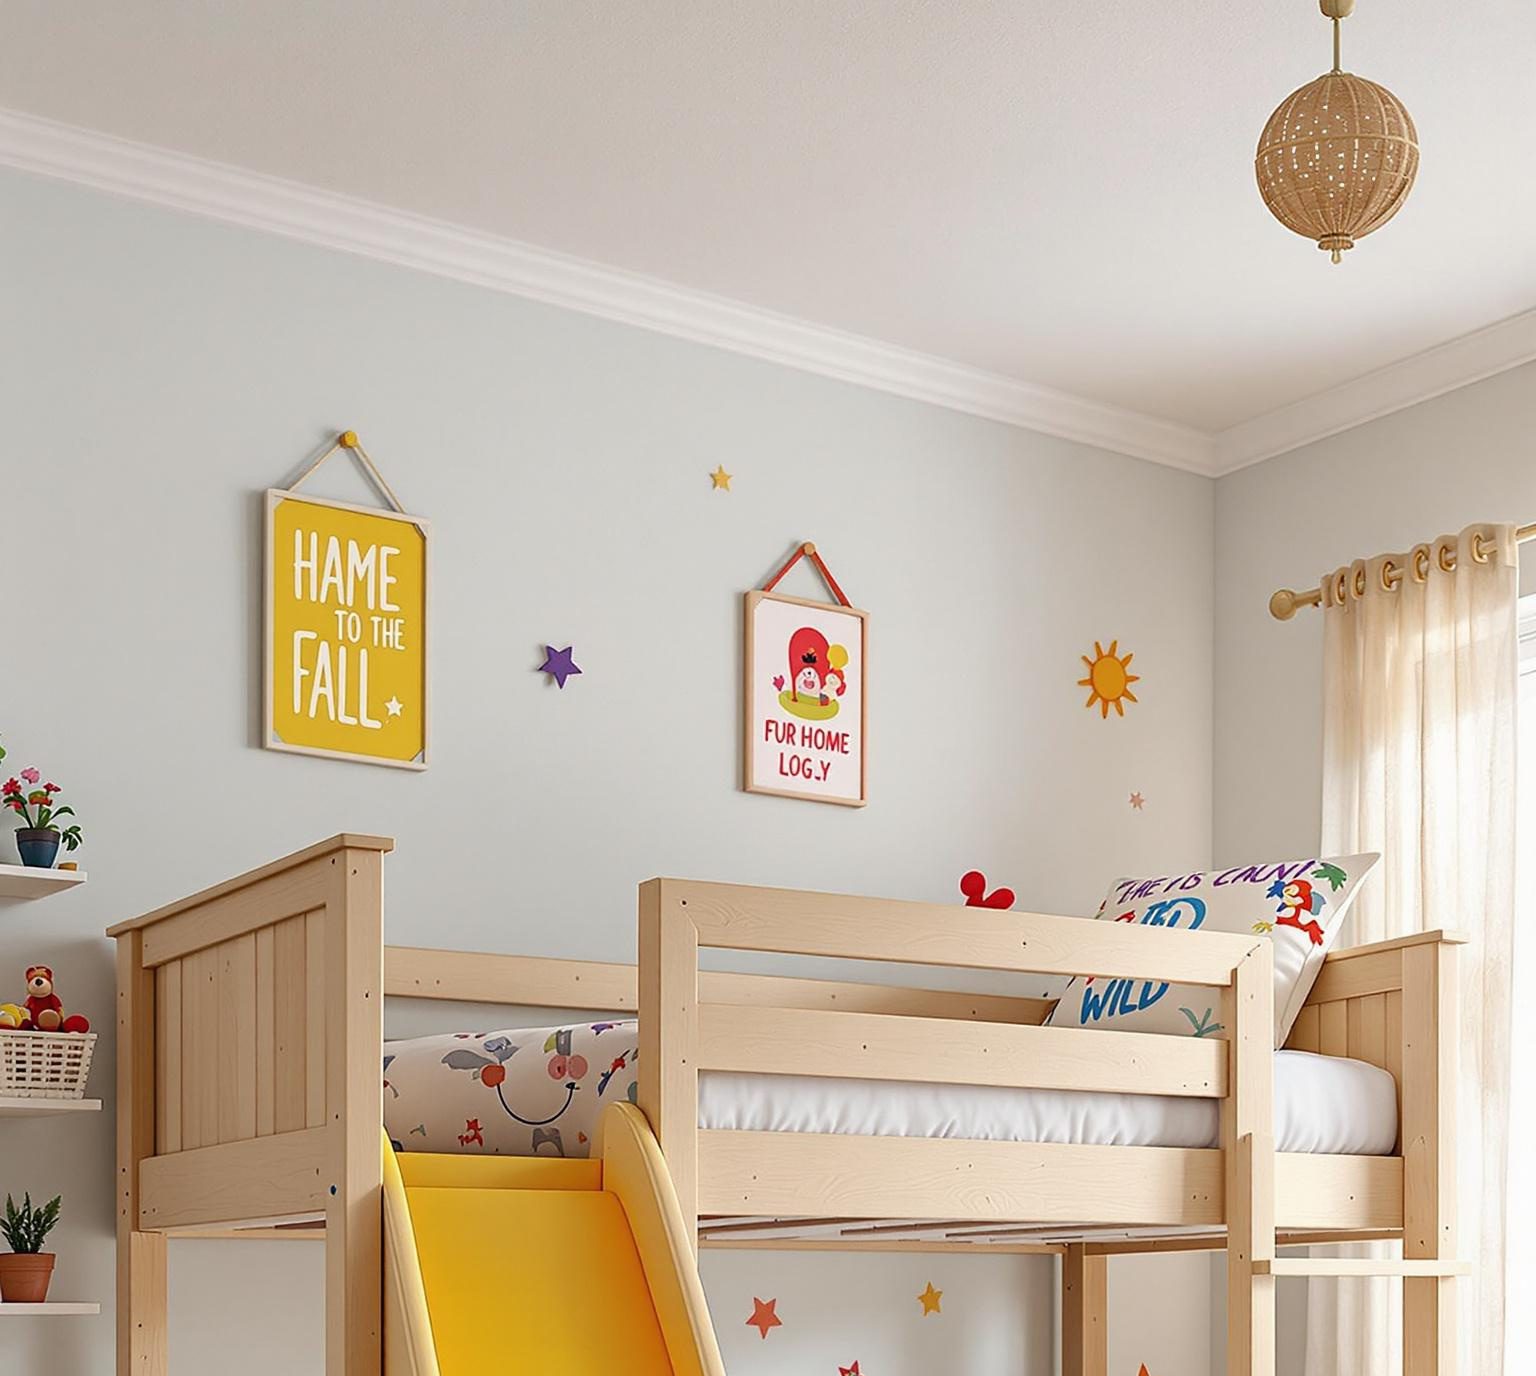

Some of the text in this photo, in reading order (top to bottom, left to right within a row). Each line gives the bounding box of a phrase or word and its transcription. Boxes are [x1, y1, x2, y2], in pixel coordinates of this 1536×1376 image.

[293, 528, 401, 613] HAME
[334, 608, 406, 651] TO THE
[293, 629, 383, 729] FALL
[764, 718, 850, 755] FUR HOME
